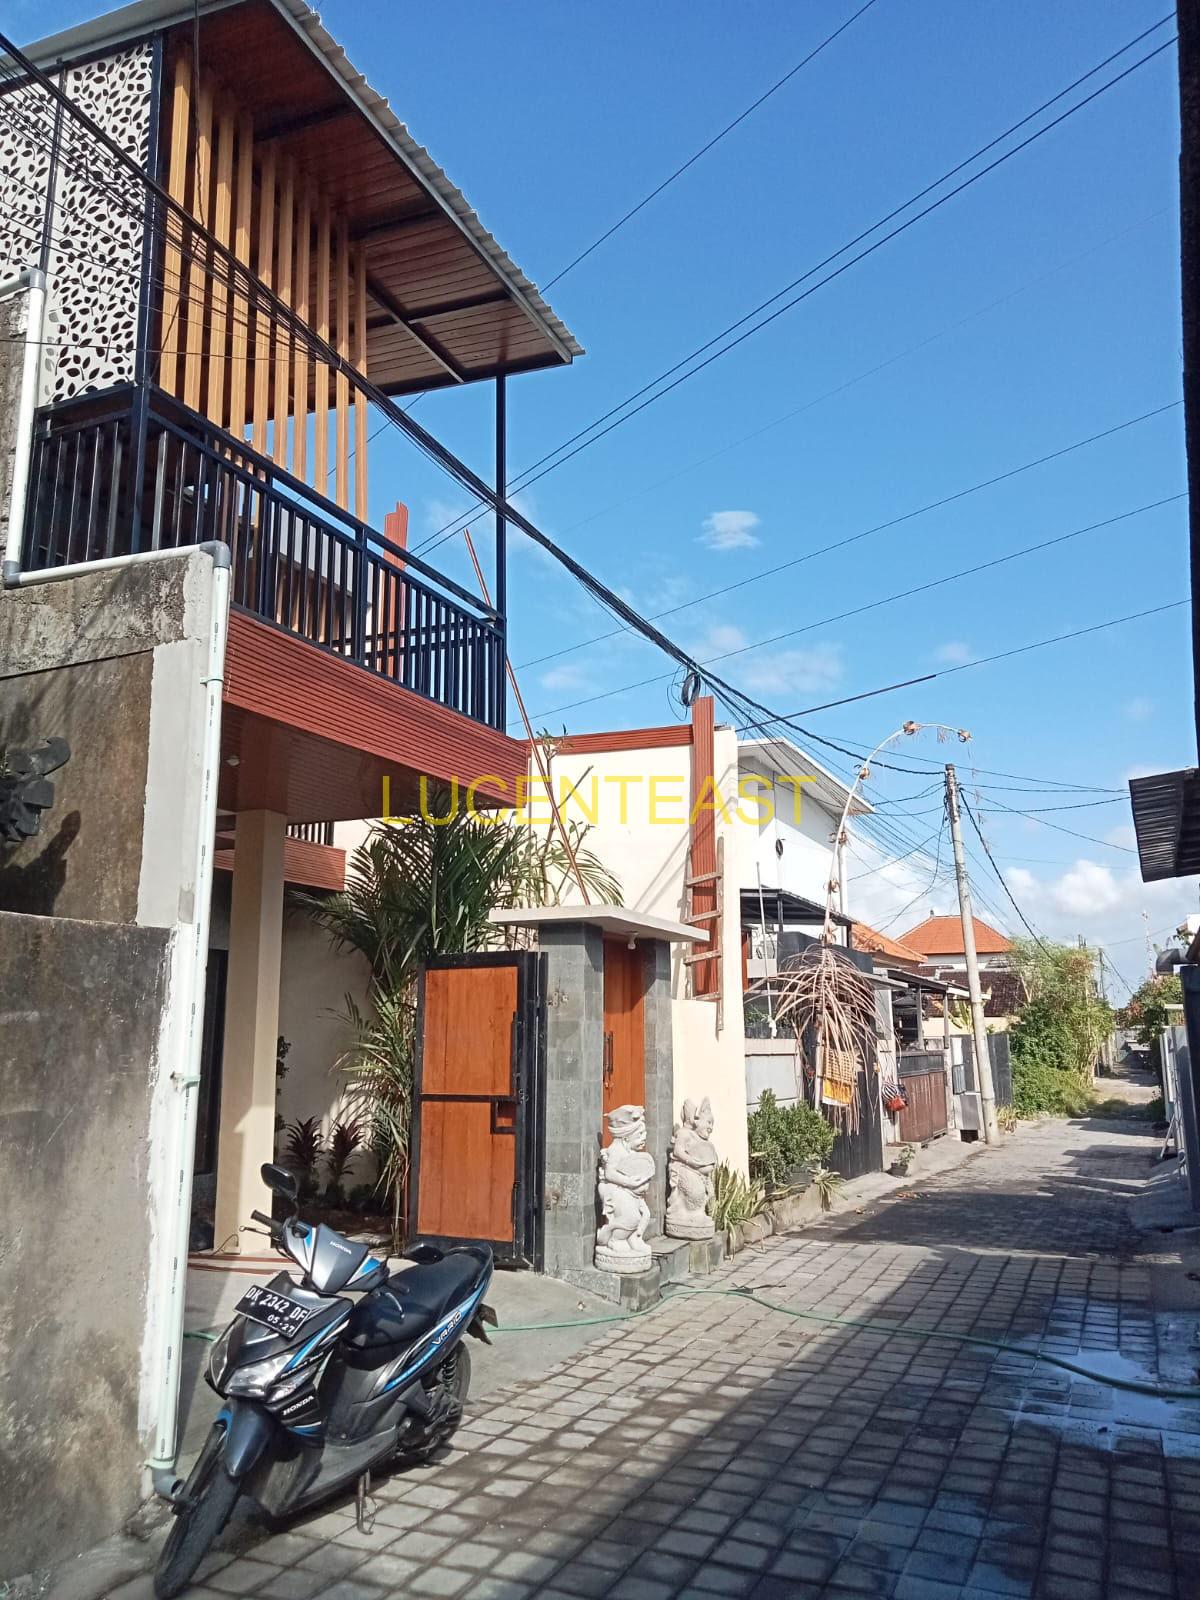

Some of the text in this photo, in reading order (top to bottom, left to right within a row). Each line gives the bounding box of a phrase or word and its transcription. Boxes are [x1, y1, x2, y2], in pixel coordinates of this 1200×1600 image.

[329, 1241, 352, 1255] HONDA
[245, 1287, 308, 1321] DK 2342 DF
[431, 1310, 462, 1345] VARIO
[282, 1395, 315, 1415] HONDA
